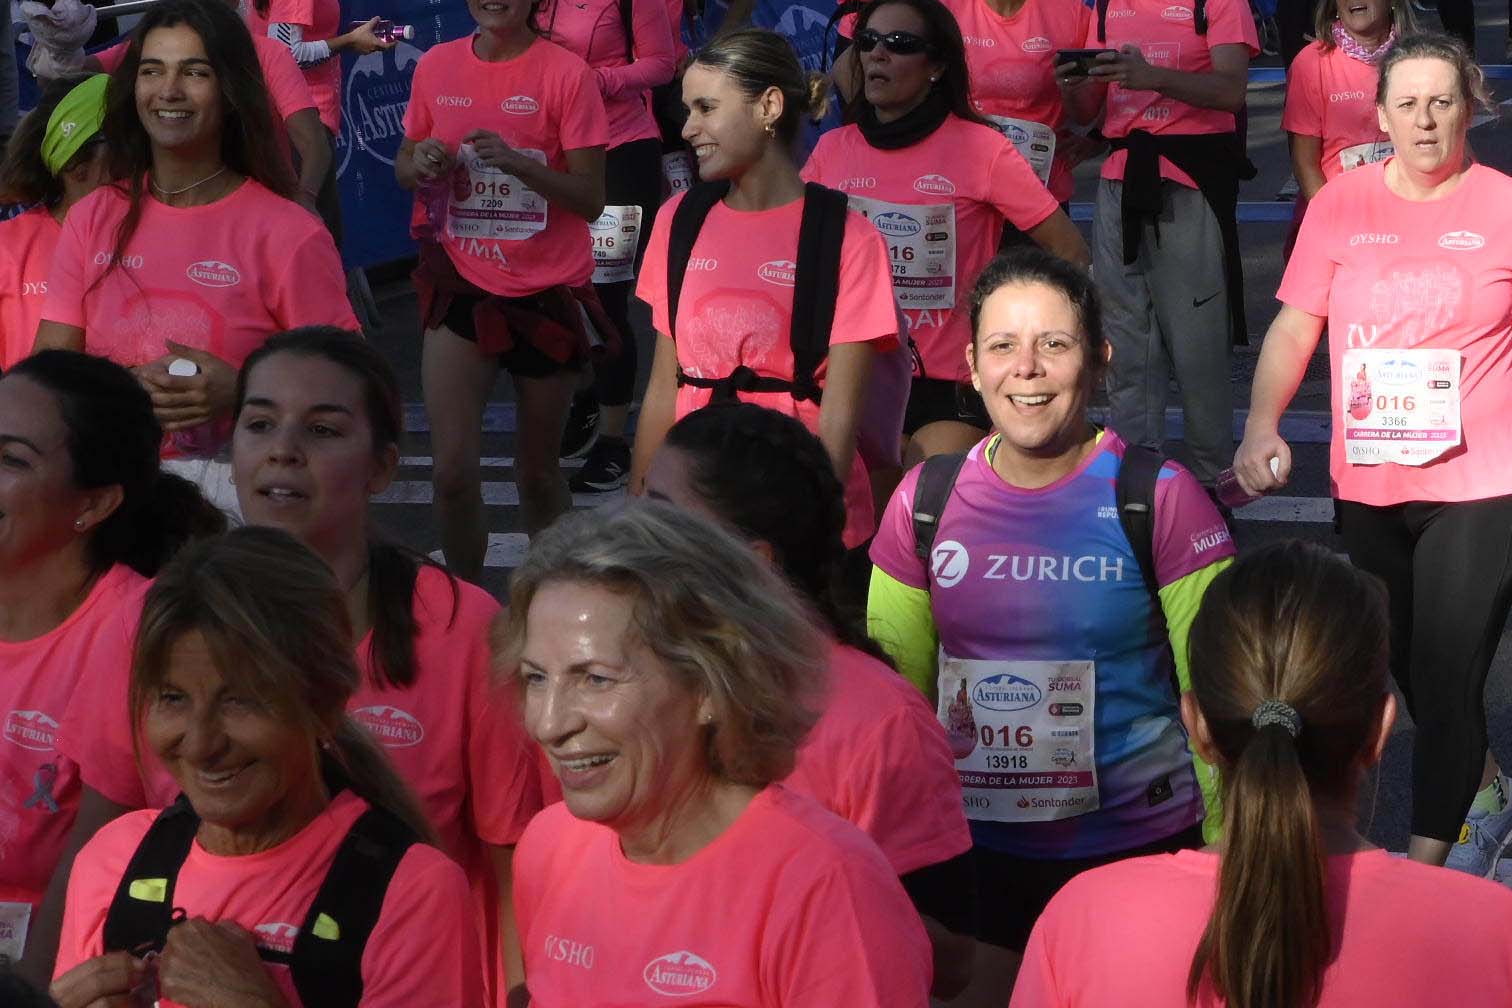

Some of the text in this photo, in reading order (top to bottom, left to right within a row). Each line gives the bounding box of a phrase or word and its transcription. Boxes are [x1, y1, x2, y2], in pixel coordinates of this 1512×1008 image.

[436, 95, 472, 108] OYSHO
[475, 181, 510, 196] 016
[917, 179, 953, 193] ASTURIANA
[481, 199, 503, 208] 7209
[876, 218, 918, 233] ASTURIANA
[1350, 233, 1398, 246] OYSHO
[190, 265, 239, 287] ASTURIANA
[902, 278, 926, 287] MUJER
[909, 292, 946, 302] Santander
[1376, 395, 1415, 411] 016
[1382, 416, 1407, 426] 3366
[983, 555, 1123, 582] ZURICH
[1048, 682, 1082, 692] SUMA
[977, 687, 1036, 703] ASTURIANA
[981, 725, 1034, 747] 016
[986, 755, 1028, 769] 13918
[988, 776, 1001, 785] DE
[1004, 777, 1016, 785] LA
[1019, 776, 1053, 785] MUJER
[1057, 775, 1079, 784] 2023
[1031, 796, 1085, 809] Santander
[651, 968, 711, 991] ASTURIANA
